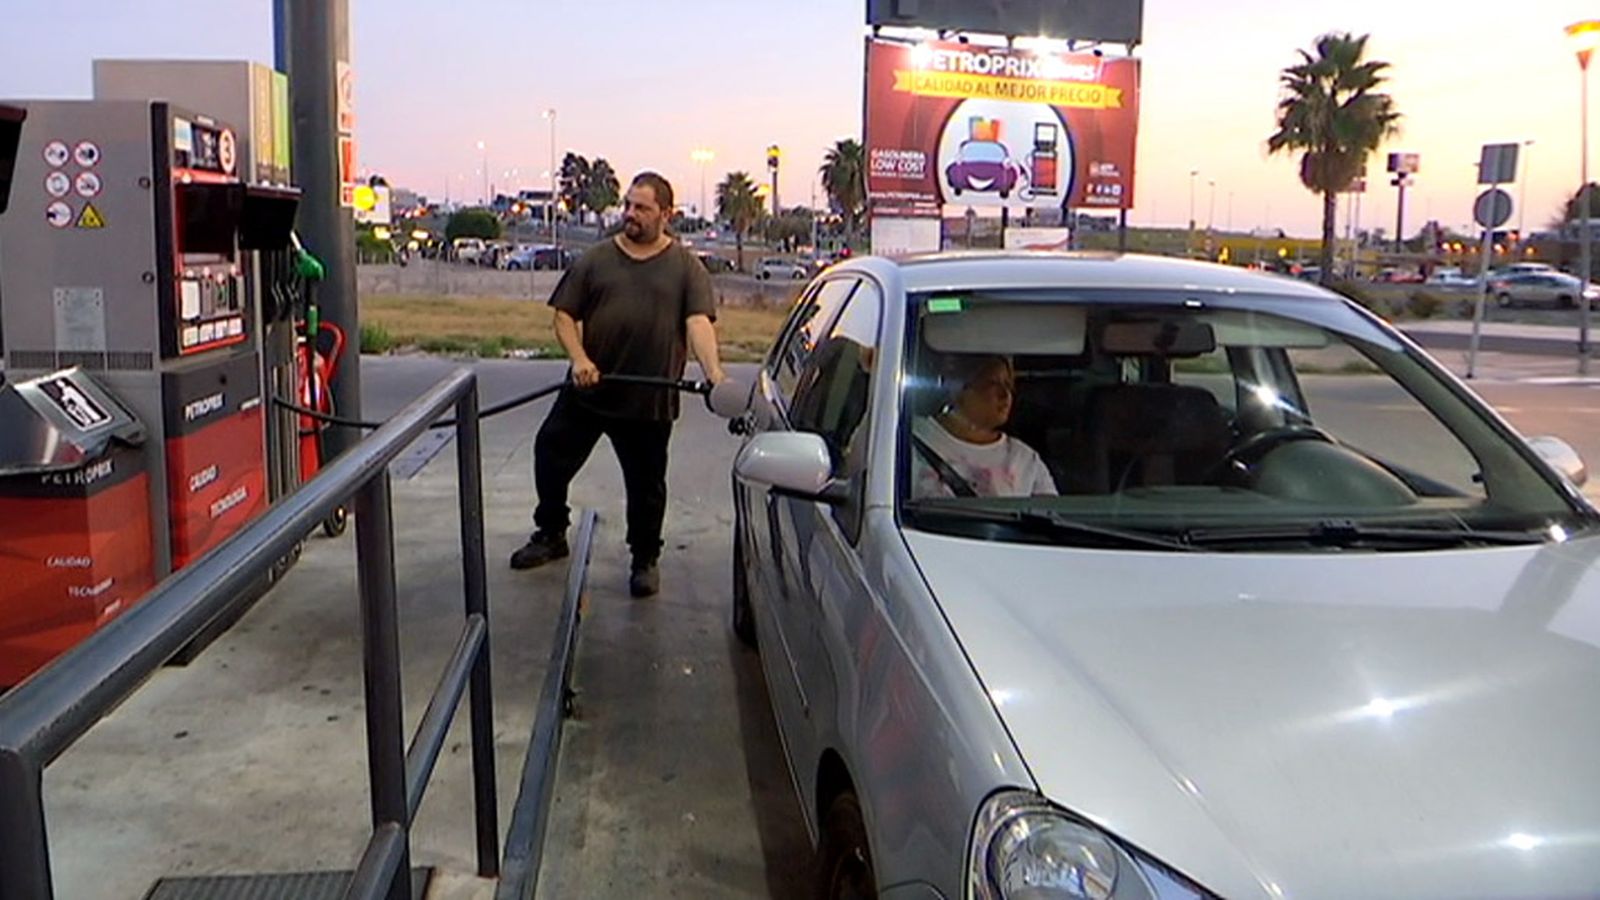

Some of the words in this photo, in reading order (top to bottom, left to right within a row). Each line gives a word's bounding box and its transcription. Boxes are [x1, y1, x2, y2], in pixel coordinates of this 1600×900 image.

[915, 76, 973, 94] CALIDAD
[976, 80, 992, 96] AL
[994, 81, 1047, 100] MEJOR
[1049, 85, 1102, 105] PRECIO
[870, 158, 897, 172] LOW
[898, 160, 926, 174] COST
[185, 393, 223, 420] PETROPRIX
[188, 464, 218, 493] CALIDAD
[47, 556, 92, 568] CALIDAD
